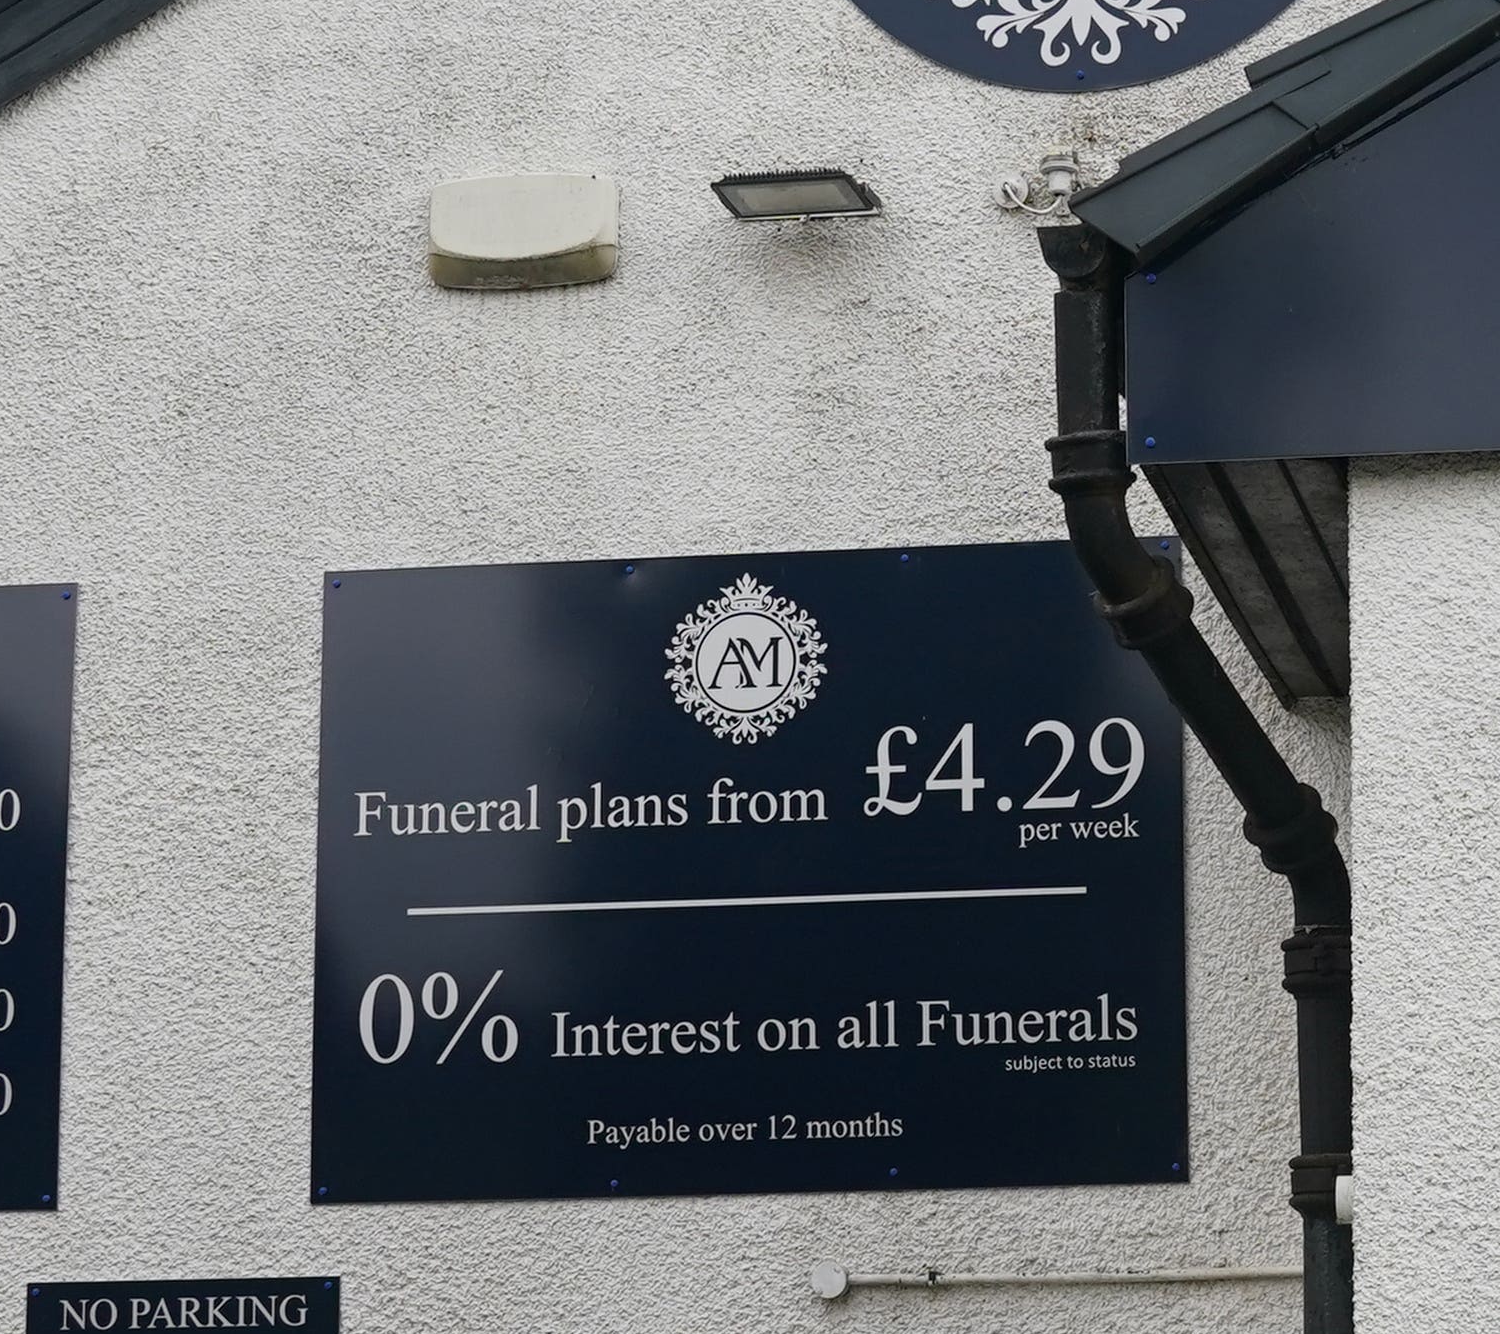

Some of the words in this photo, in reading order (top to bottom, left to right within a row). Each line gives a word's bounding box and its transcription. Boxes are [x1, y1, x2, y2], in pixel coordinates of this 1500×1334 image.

[354, 785, 540, 836] Funeral
[557, 782, 688, 842] plans
[707, 778, 828, 824] from
[864, 718, 1144, 816] £4.29
[1019, 823, 1061, 848] per
[1070, 813, 1139, 838] week
[360, 970, 518, 1064] 0%
[551, 1012, 740, 1057] Interest
[758, 1018, 820, 1051] on
[838, 1000, 898, 1048] all
[917, 994, 1137, 1046] Funerals
[1006, 1056, 1062, 1073] subject
[1067, 1056, 1083, 1068] to
[1089, 1055, 1135, 1068] status
[588, 1118, 689, 1149] Payable
[699, 1123, 757, 1141] over
[769, 1115, 797, 1139] 12
[807, 1112, 903, 1138] months
[60, 1299, 117, 1330] NO
[129, 1295, 308, 1328] PARKING
